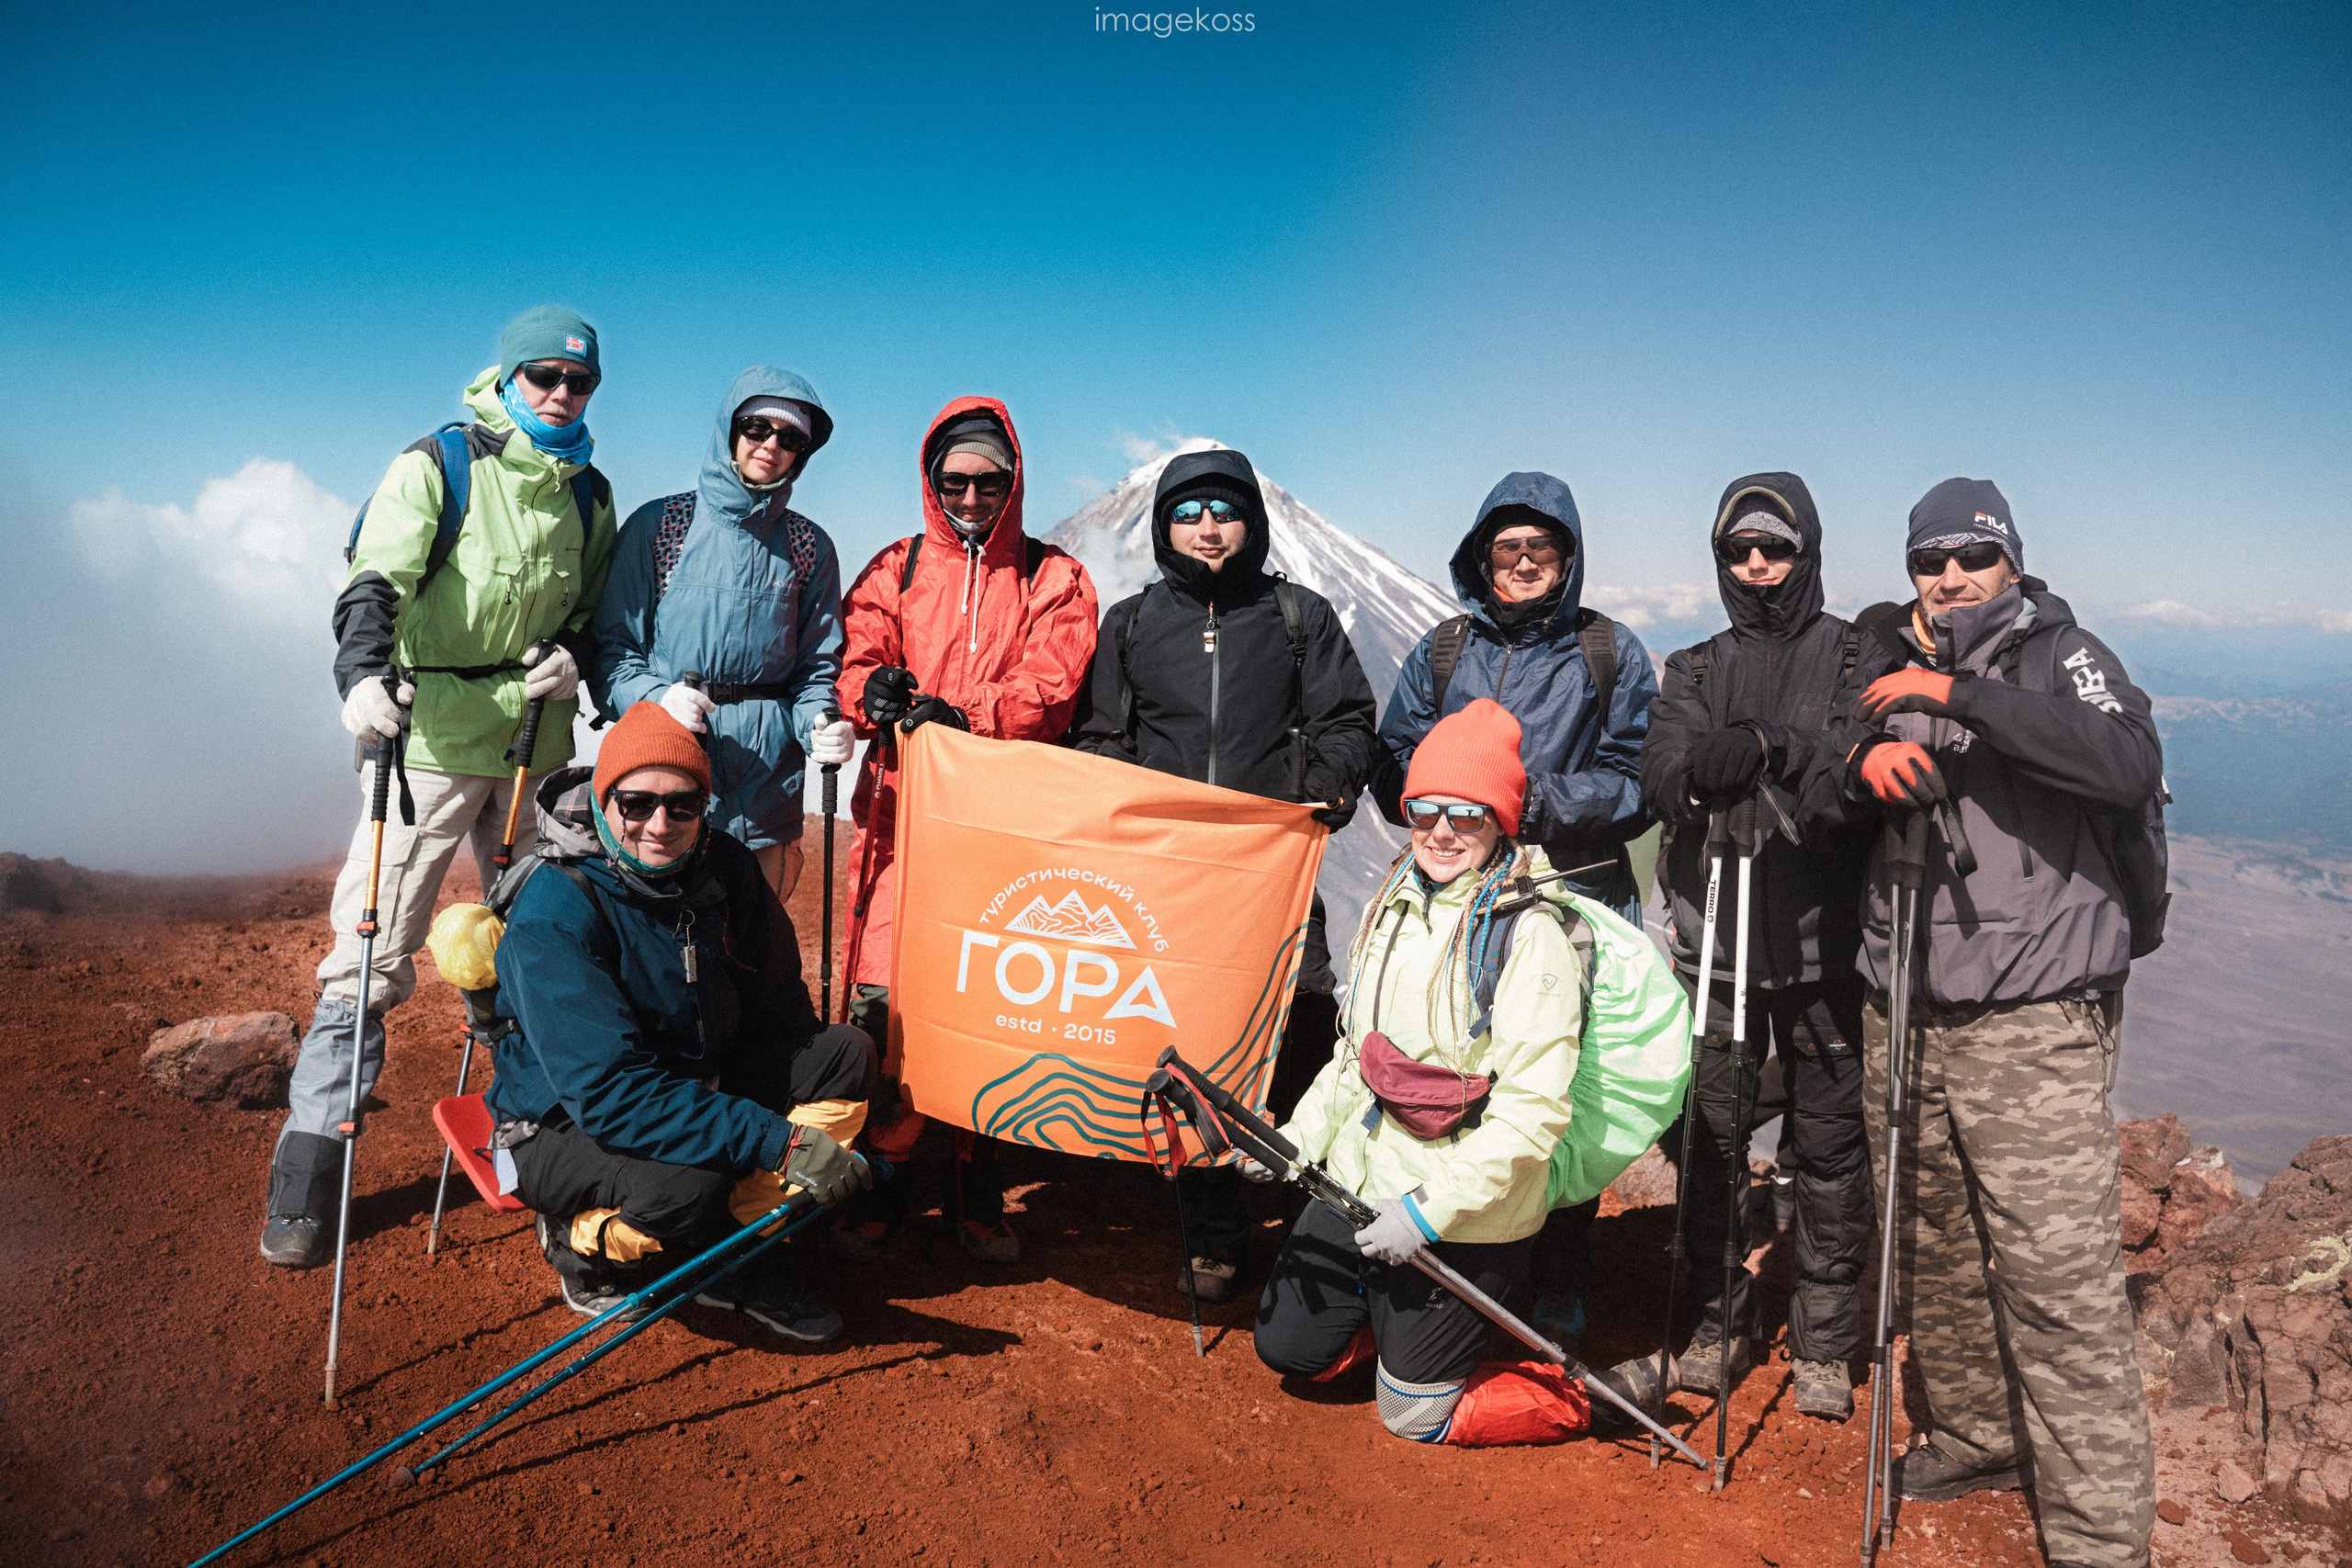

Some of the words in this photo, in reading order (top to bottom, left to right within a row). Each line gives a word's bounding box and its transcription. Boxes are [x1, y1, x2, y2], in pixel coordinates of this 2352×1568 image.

[1974, 512, 2009, 535] FILA
[978, 867, 1135, 924] туристический
[1133, 901, 1170, 953] клуб
[1708, 879, 1717, 914] TERRO
[956, 930, 1178, 1029] ГОРА
[995, 1014, 1043, 1033] estd
[1064, 1023, 1117, 1045] 2015
